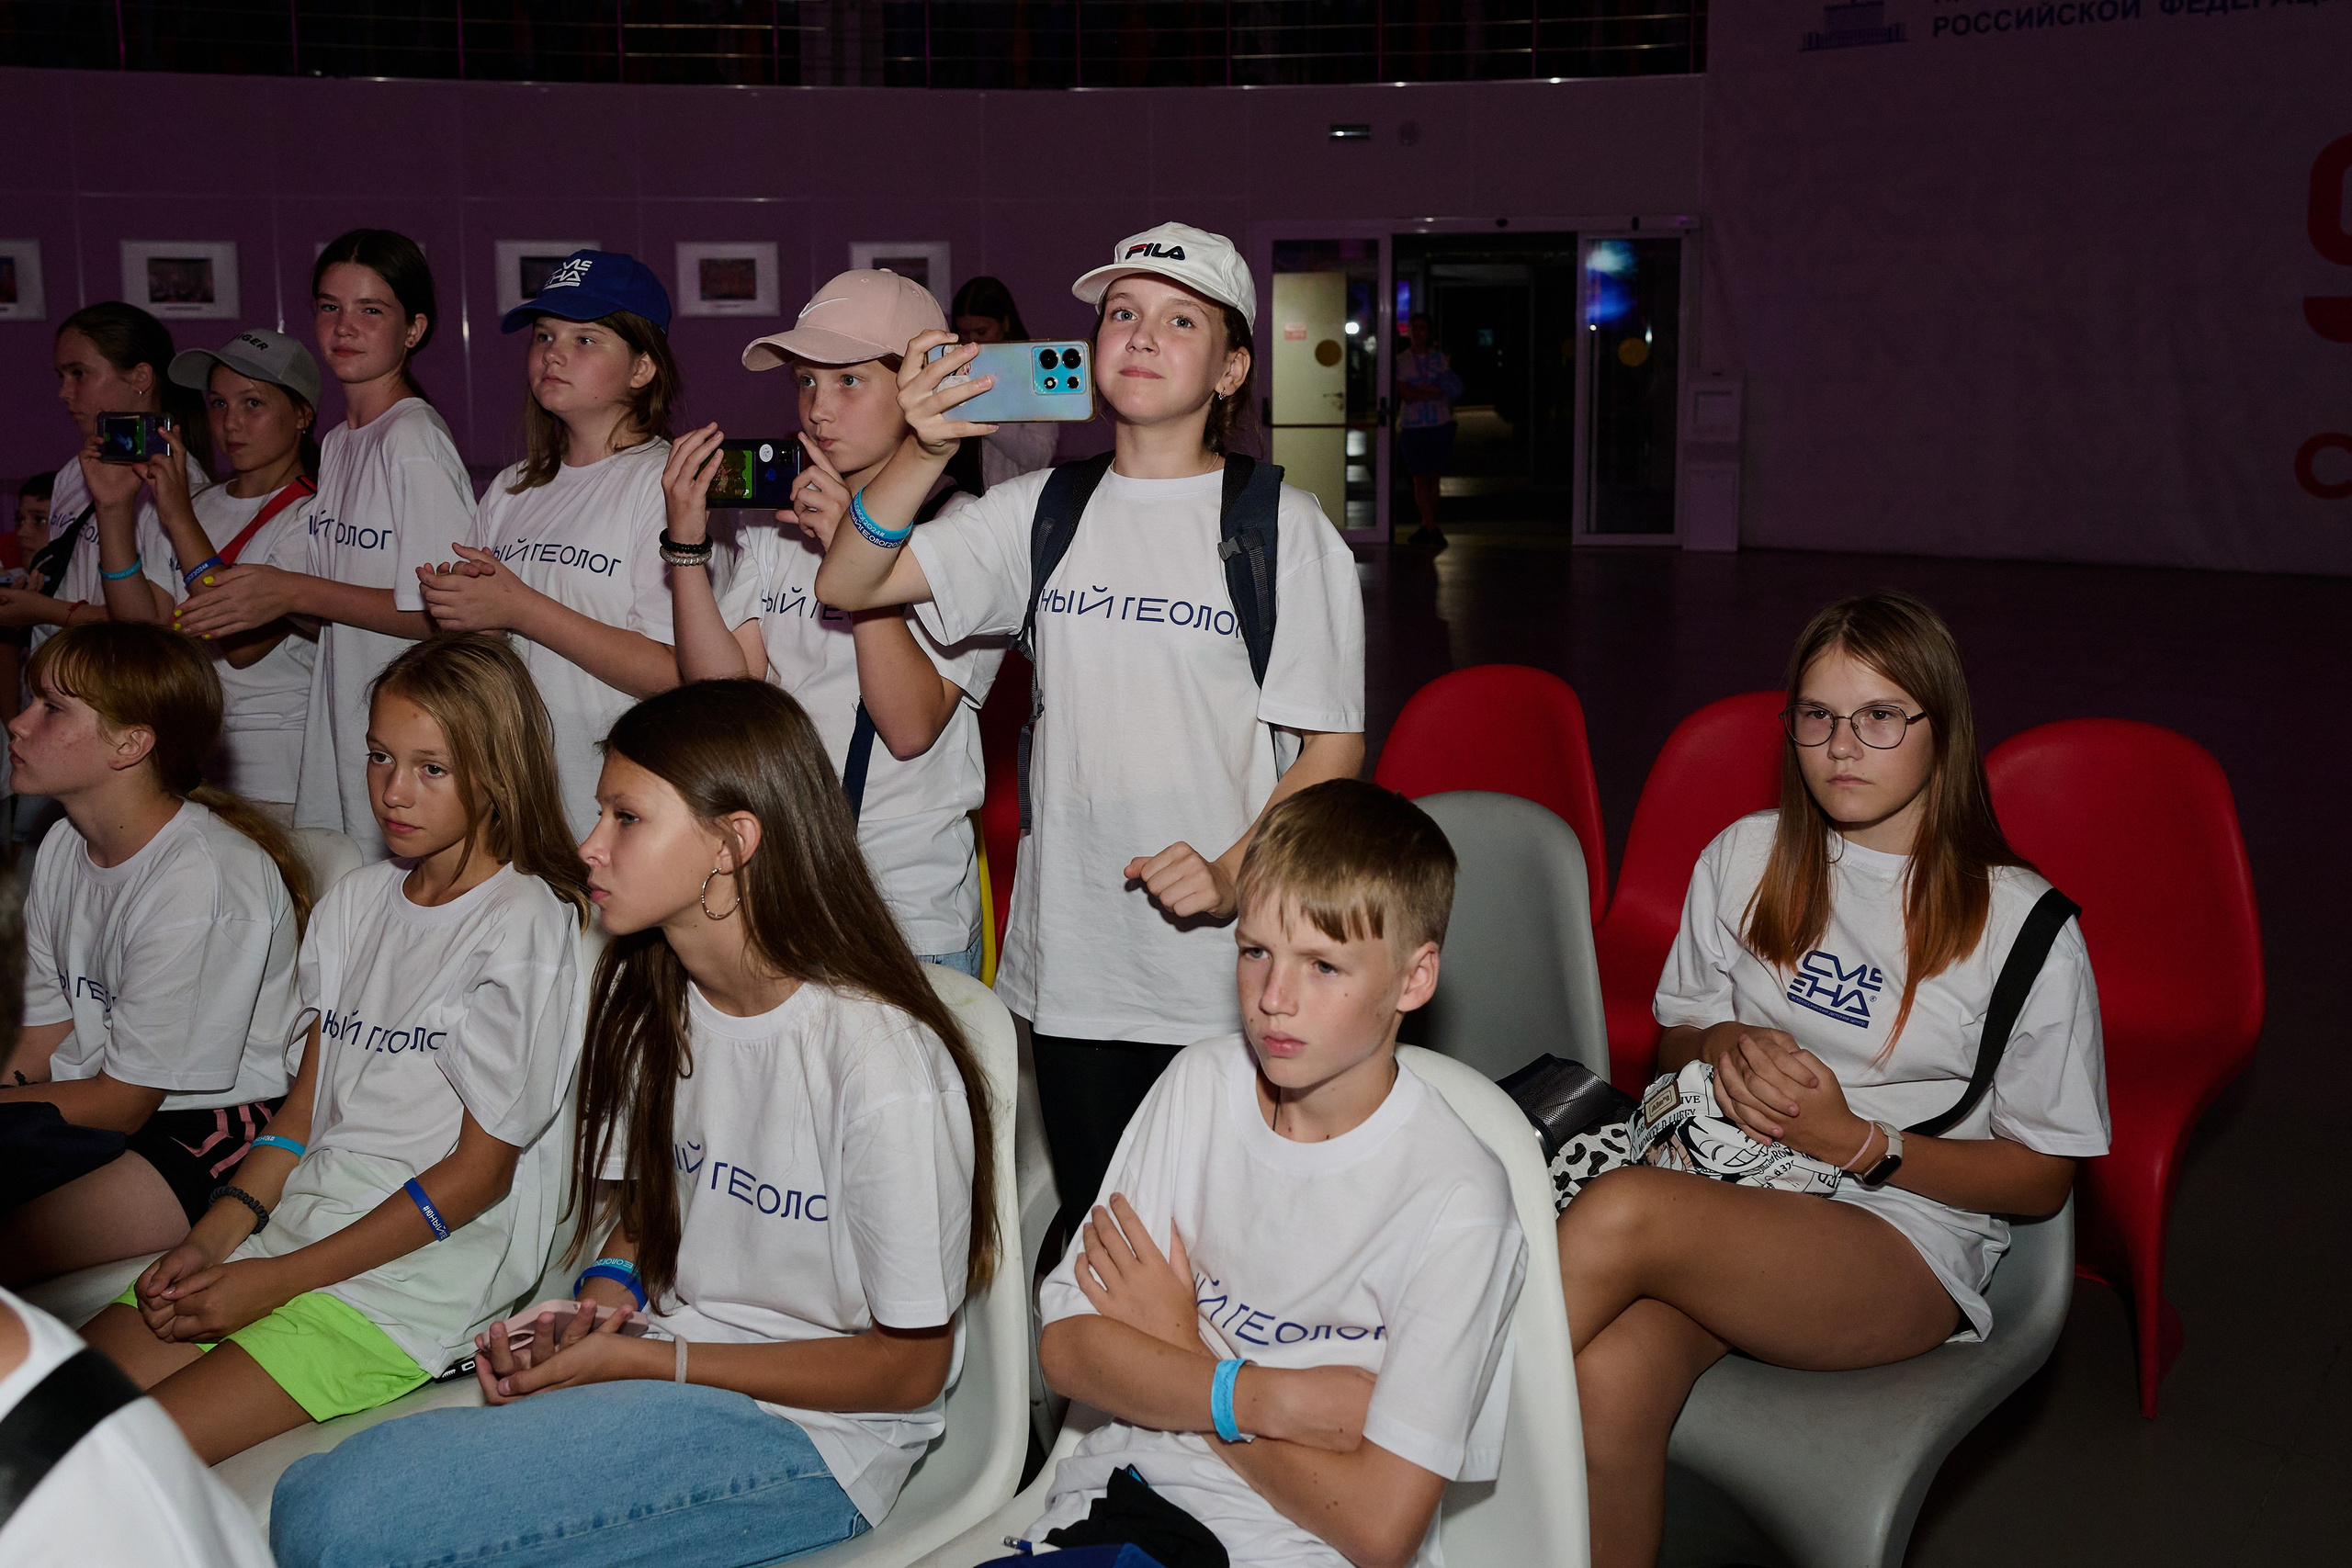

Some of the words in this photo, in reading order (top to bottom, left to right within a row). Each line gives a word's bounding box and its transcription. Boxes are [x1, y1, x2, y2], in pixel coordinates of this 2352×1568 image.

[1933, 0, 2141, 38] РОССИЙСКОЙ
[1125, 243, 1186, 261] FILA
[530, 543, 622, 577] ГЕОЛОГ
